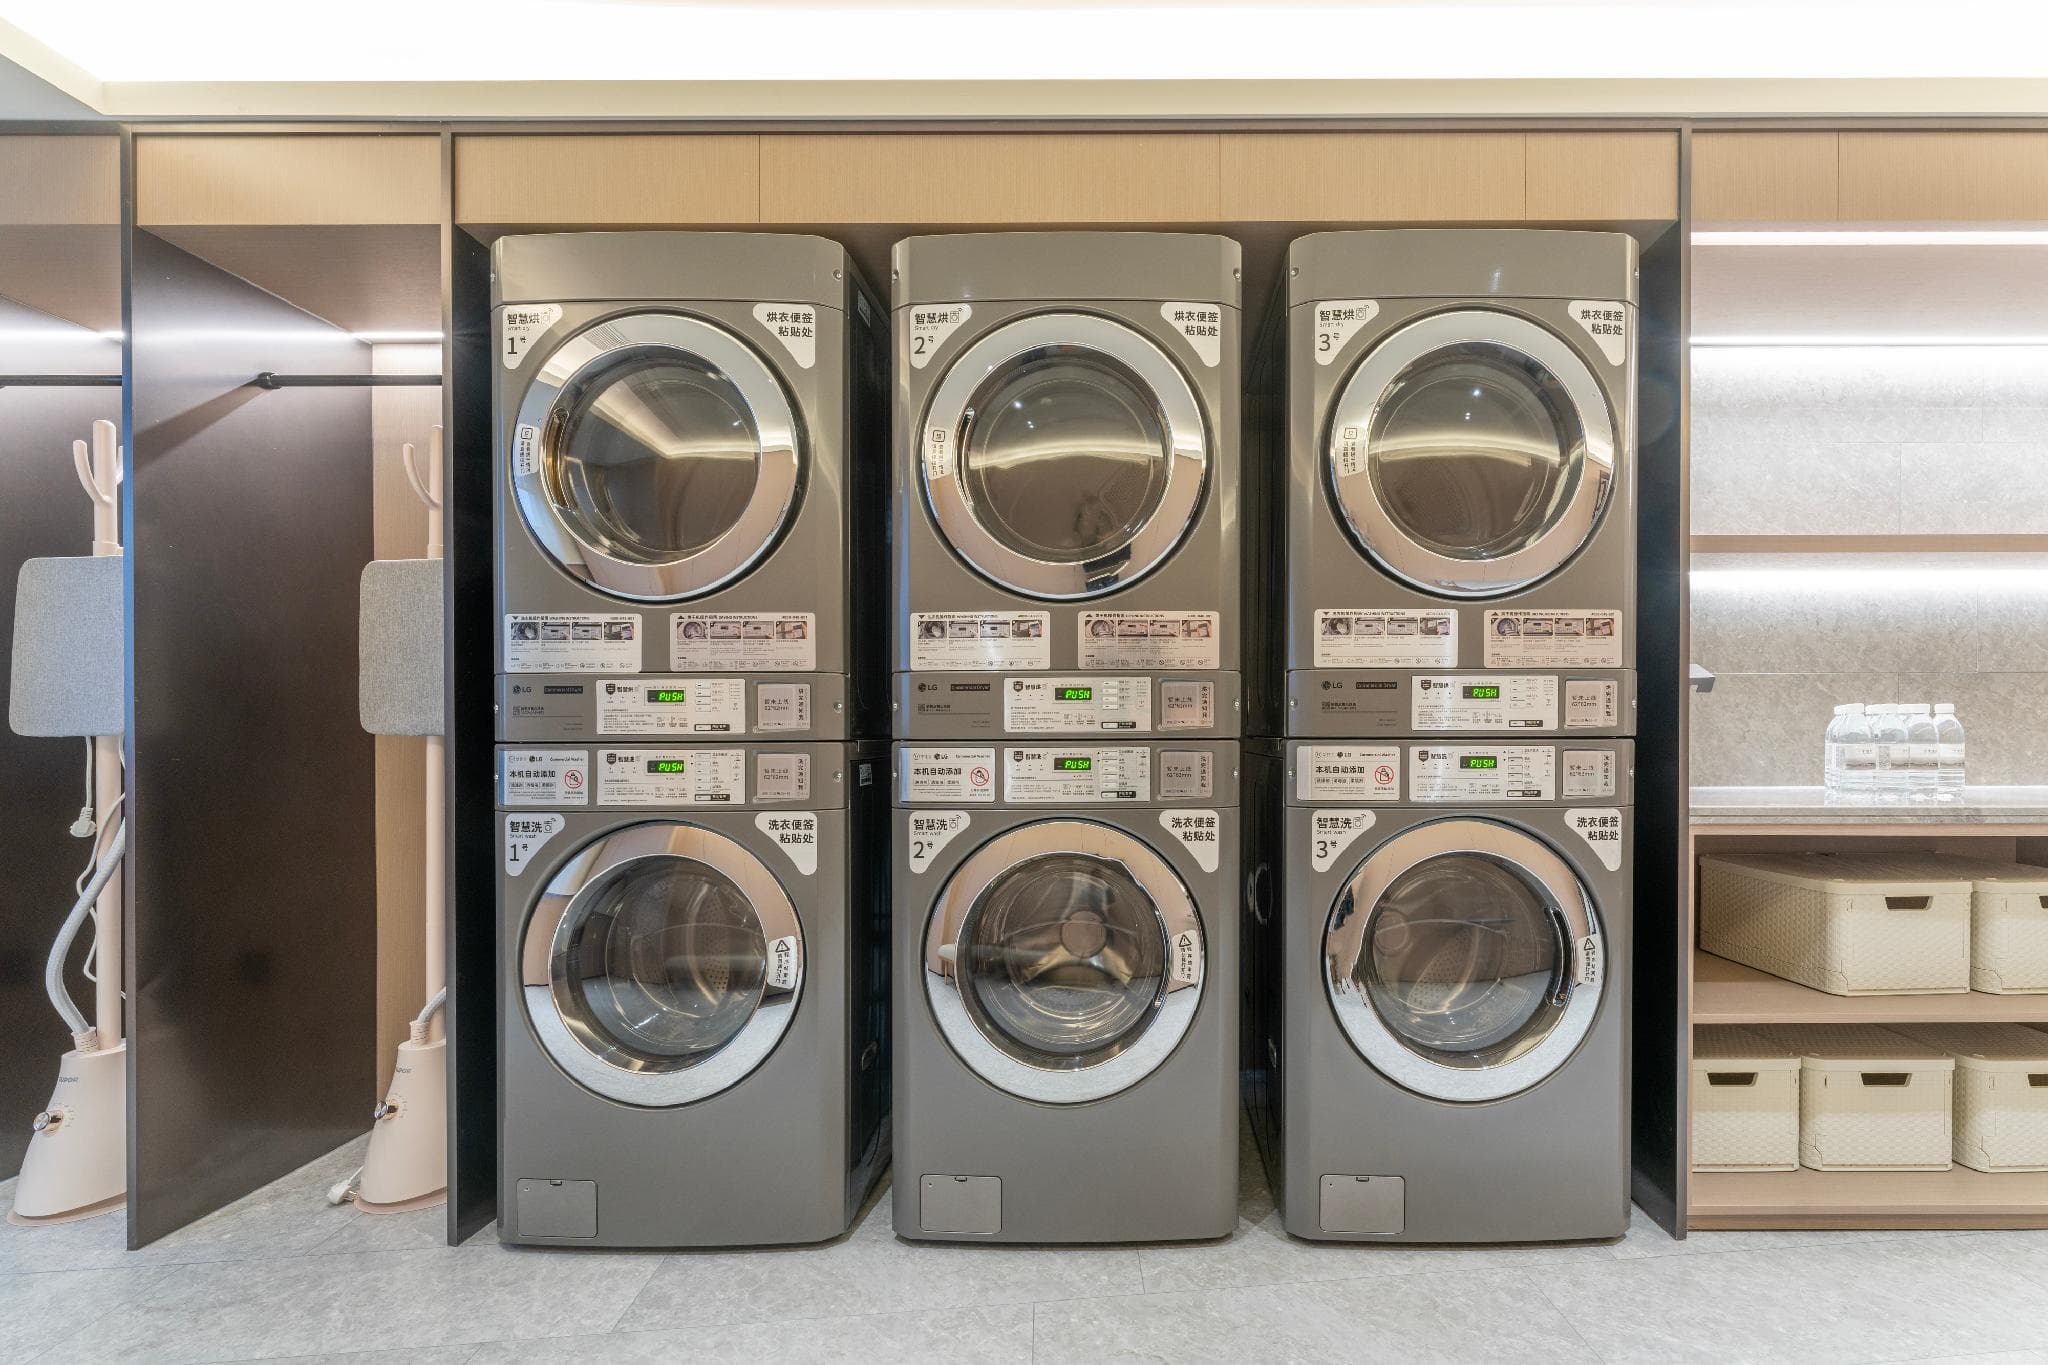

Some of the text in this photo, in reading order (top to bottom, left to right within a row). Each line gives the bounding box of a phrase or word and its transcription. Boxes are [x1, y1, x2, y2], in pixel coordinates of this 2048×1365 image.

[507, 313, 540, 325] 智慧烘
[766, 311, 813, 323] 烘衣便签
[914, 311, 948, 324] 智慧烘
[1174, 310, 1219, 322] 烘衣便签
[1319, 308, 1355, 321] 智慧烘
[1580, 309, 1623, 321] 烘衣便签
[778, 326, 813, 338] 粘贴处
[1185, 325, 1219, 336] 粘贴处
[1591, 323, 1623, 335] 粘贴处
[659, 691, 683, 701] PUSH
[1065, 689, 1090, 699] PUSH
[1472, 688, 1497, 697] PUSH
[659, 762, 683, 772] PUSH
[1064, 760, 1089, 769] PUSH
[1315, 765, 1365, 774] 本机自动添加
[1470, 759, 1495, 768] PUSH
[913, 767, 962, 776] 本机自动添加
[510, 820, 543, 833] 智慧洗
[768, 819, 815, 831] 洗衣便签
[914, 818, 948, 830] 智慧洗
[1171, 817, 1215, 828] 洗衣便签
[1316, 816, 1352, 829] 智慧洗
[1576, 816, 1619, 828] 洗衣便签
[779, 832, 815, 844] 粘贴处
[1182, 830, 1215, 842] 粘贴处
[1588, 829, 1619, 841] 粘贴处
